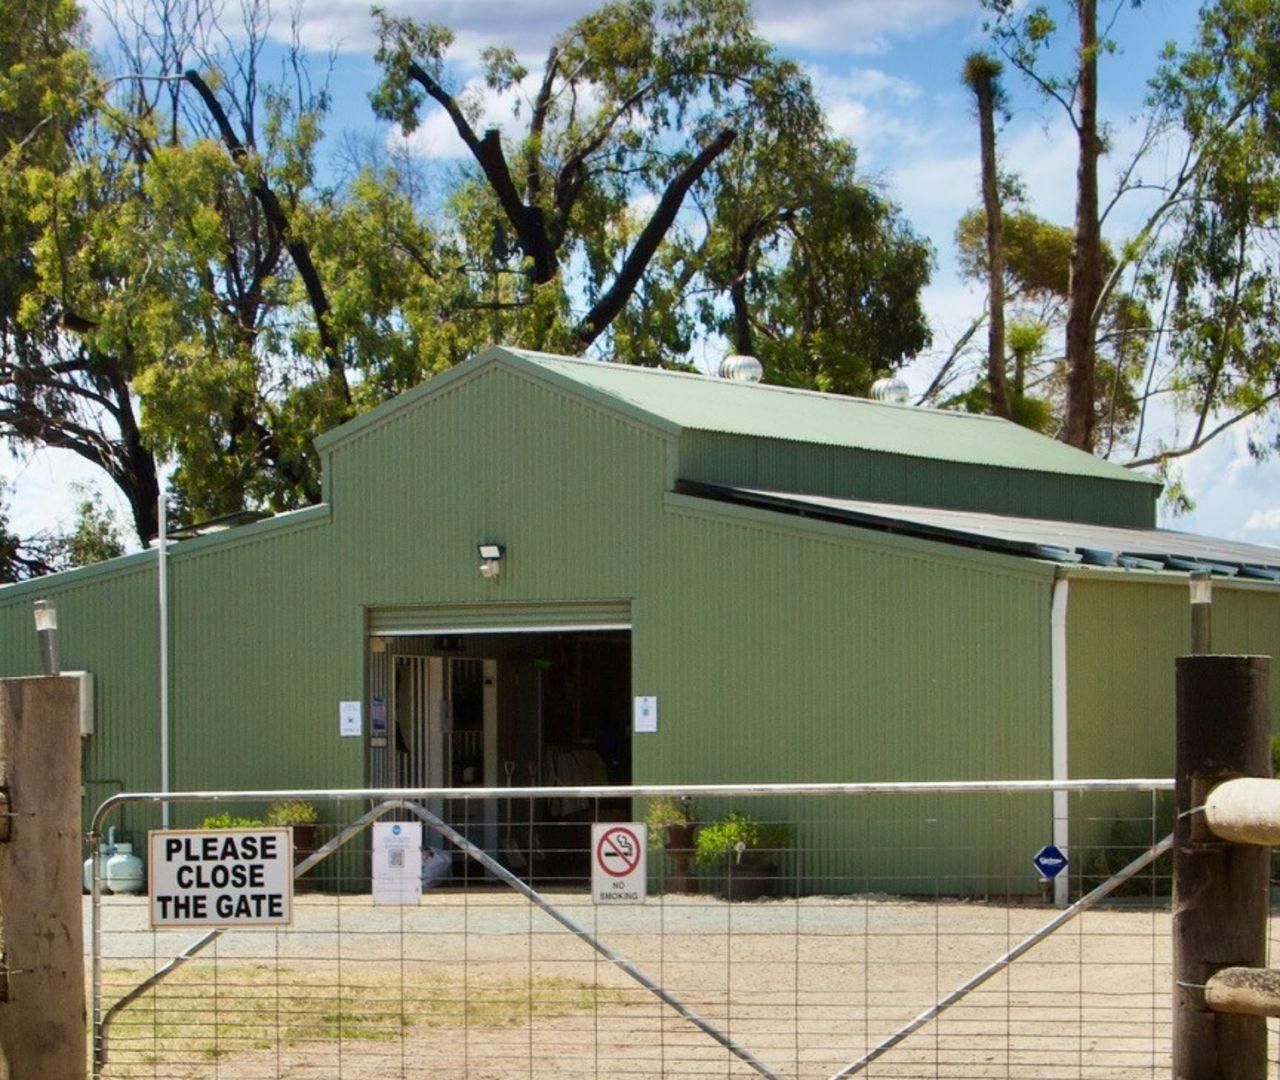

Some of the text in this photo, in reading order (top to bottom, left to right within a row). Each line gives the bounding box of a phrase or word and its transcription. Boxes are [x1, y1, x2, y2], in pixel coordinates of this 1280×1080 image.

[166, 836, 276, 861] PLEASE
[177, 864, 264, 889] CLOSE
[612, 881, 625, 890] NO
[157, 894, 282, 919] THE GATE
[600, 892, 638, 900] SMOKING
